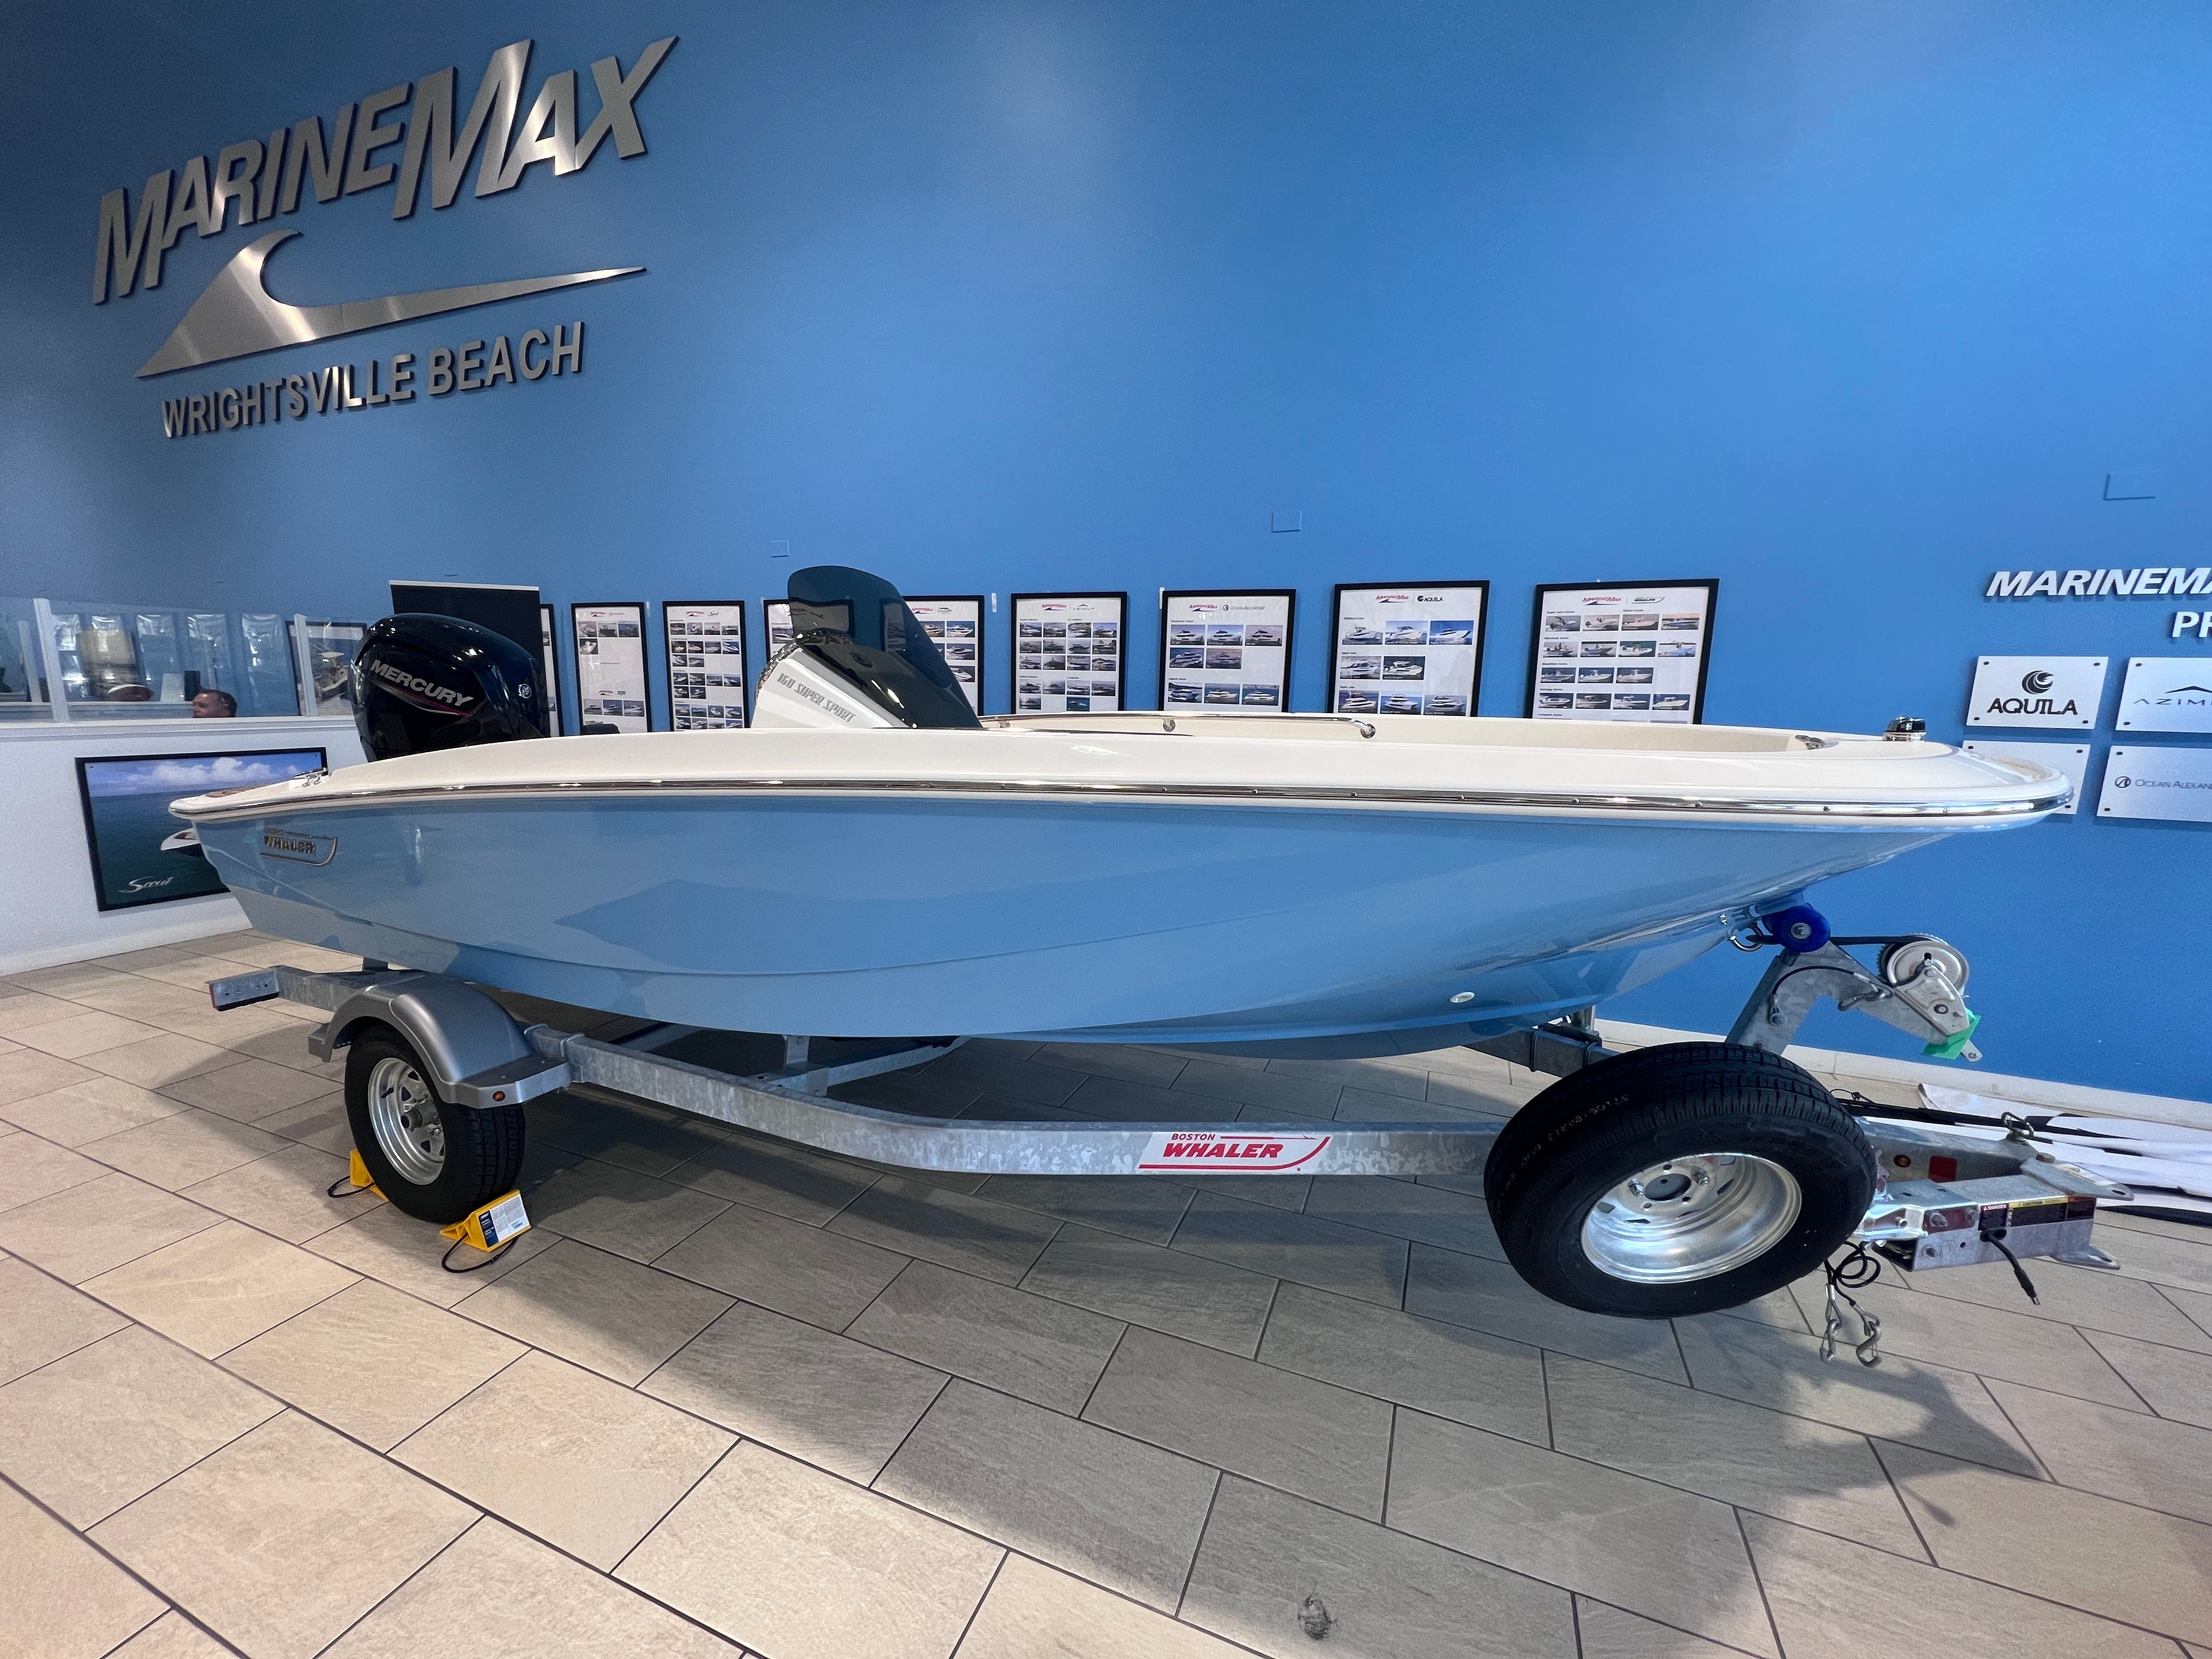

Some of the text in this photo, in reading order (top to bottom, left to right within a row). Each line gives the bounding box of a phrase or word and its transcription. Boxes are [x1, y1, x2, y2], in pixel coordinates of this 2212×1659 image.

[93, 35, 679, 305] MARINEMAX
[161, 321, 585, 438] WRIGHTSVILLE BEACH
[1985, 567, 2212, 597] MARINEM
[370, 659, 474, 707] MERCURY
[777, 673, 856, 723] 160 SUPER SPORT
[1987, 698, 2078, 716] AQUILA
[2135, 779, 2171, 788] OCEAN
[264, 835, 317, 855] WHALER
[118, 876, 174, 894] Scout
[1163, 1143, 1284, 1158] WHALER
